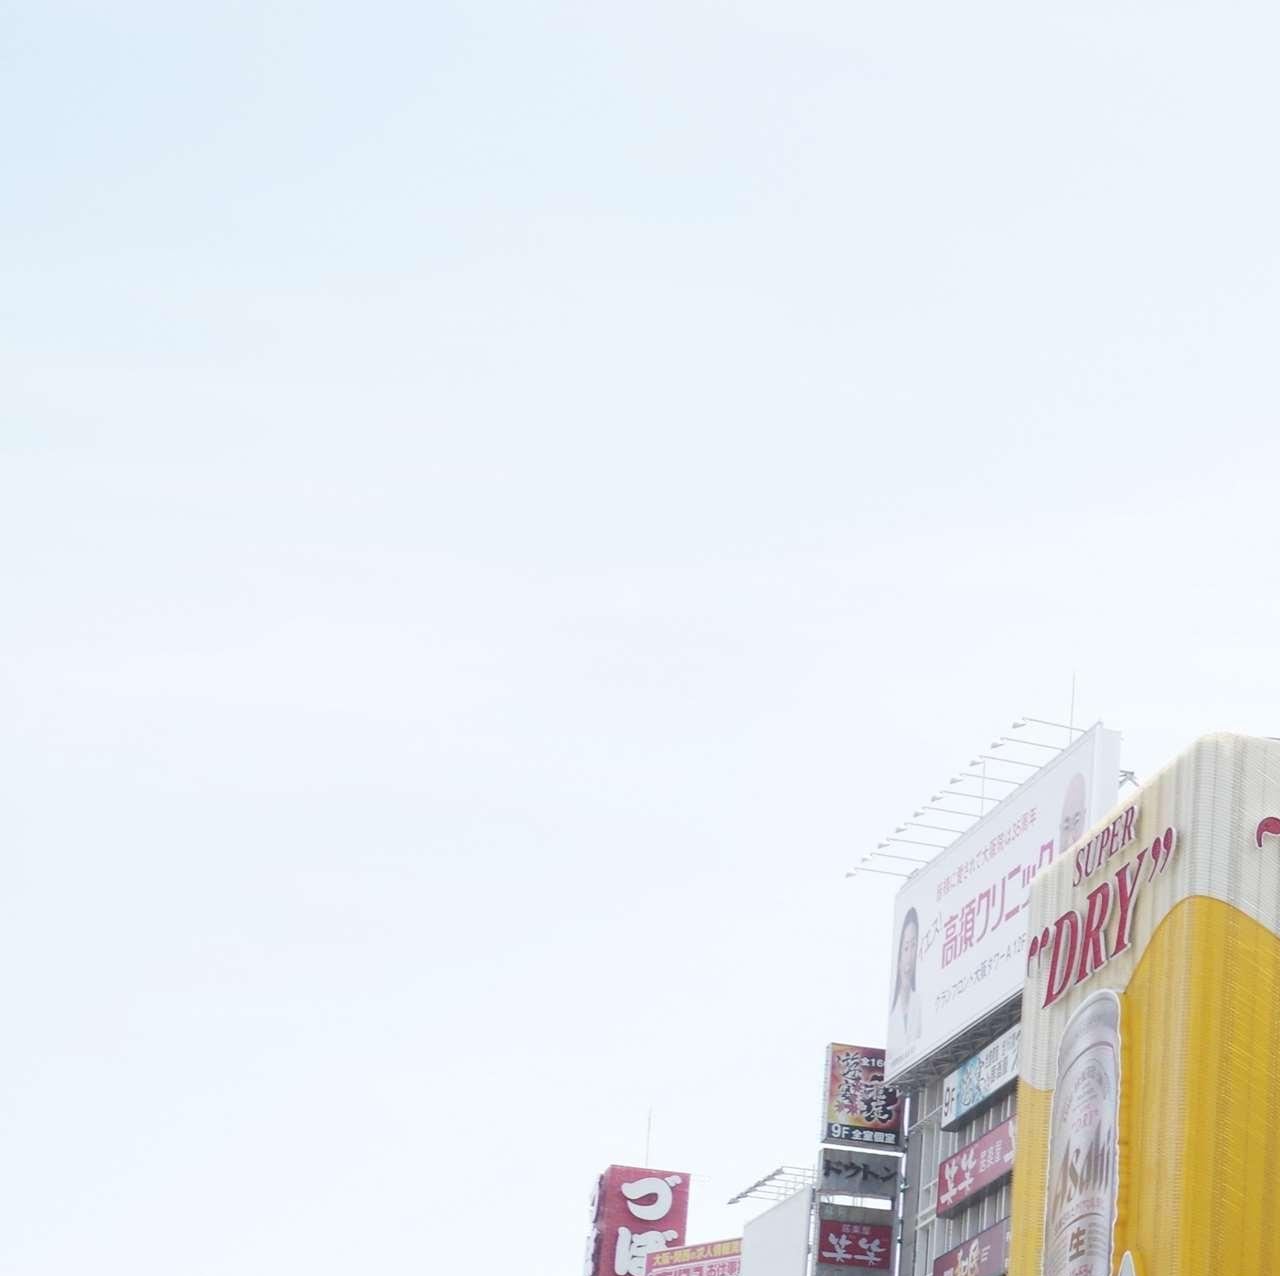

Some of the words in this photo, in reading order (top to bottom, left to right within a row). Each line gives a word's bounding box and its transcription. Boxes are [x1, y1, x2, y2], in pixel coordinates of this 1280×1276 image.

[1072, 806, 1137, 888] SUPER
[831, 1124, 851, 1139] 9F
[1068, 1225, 1086, 1263] 生
